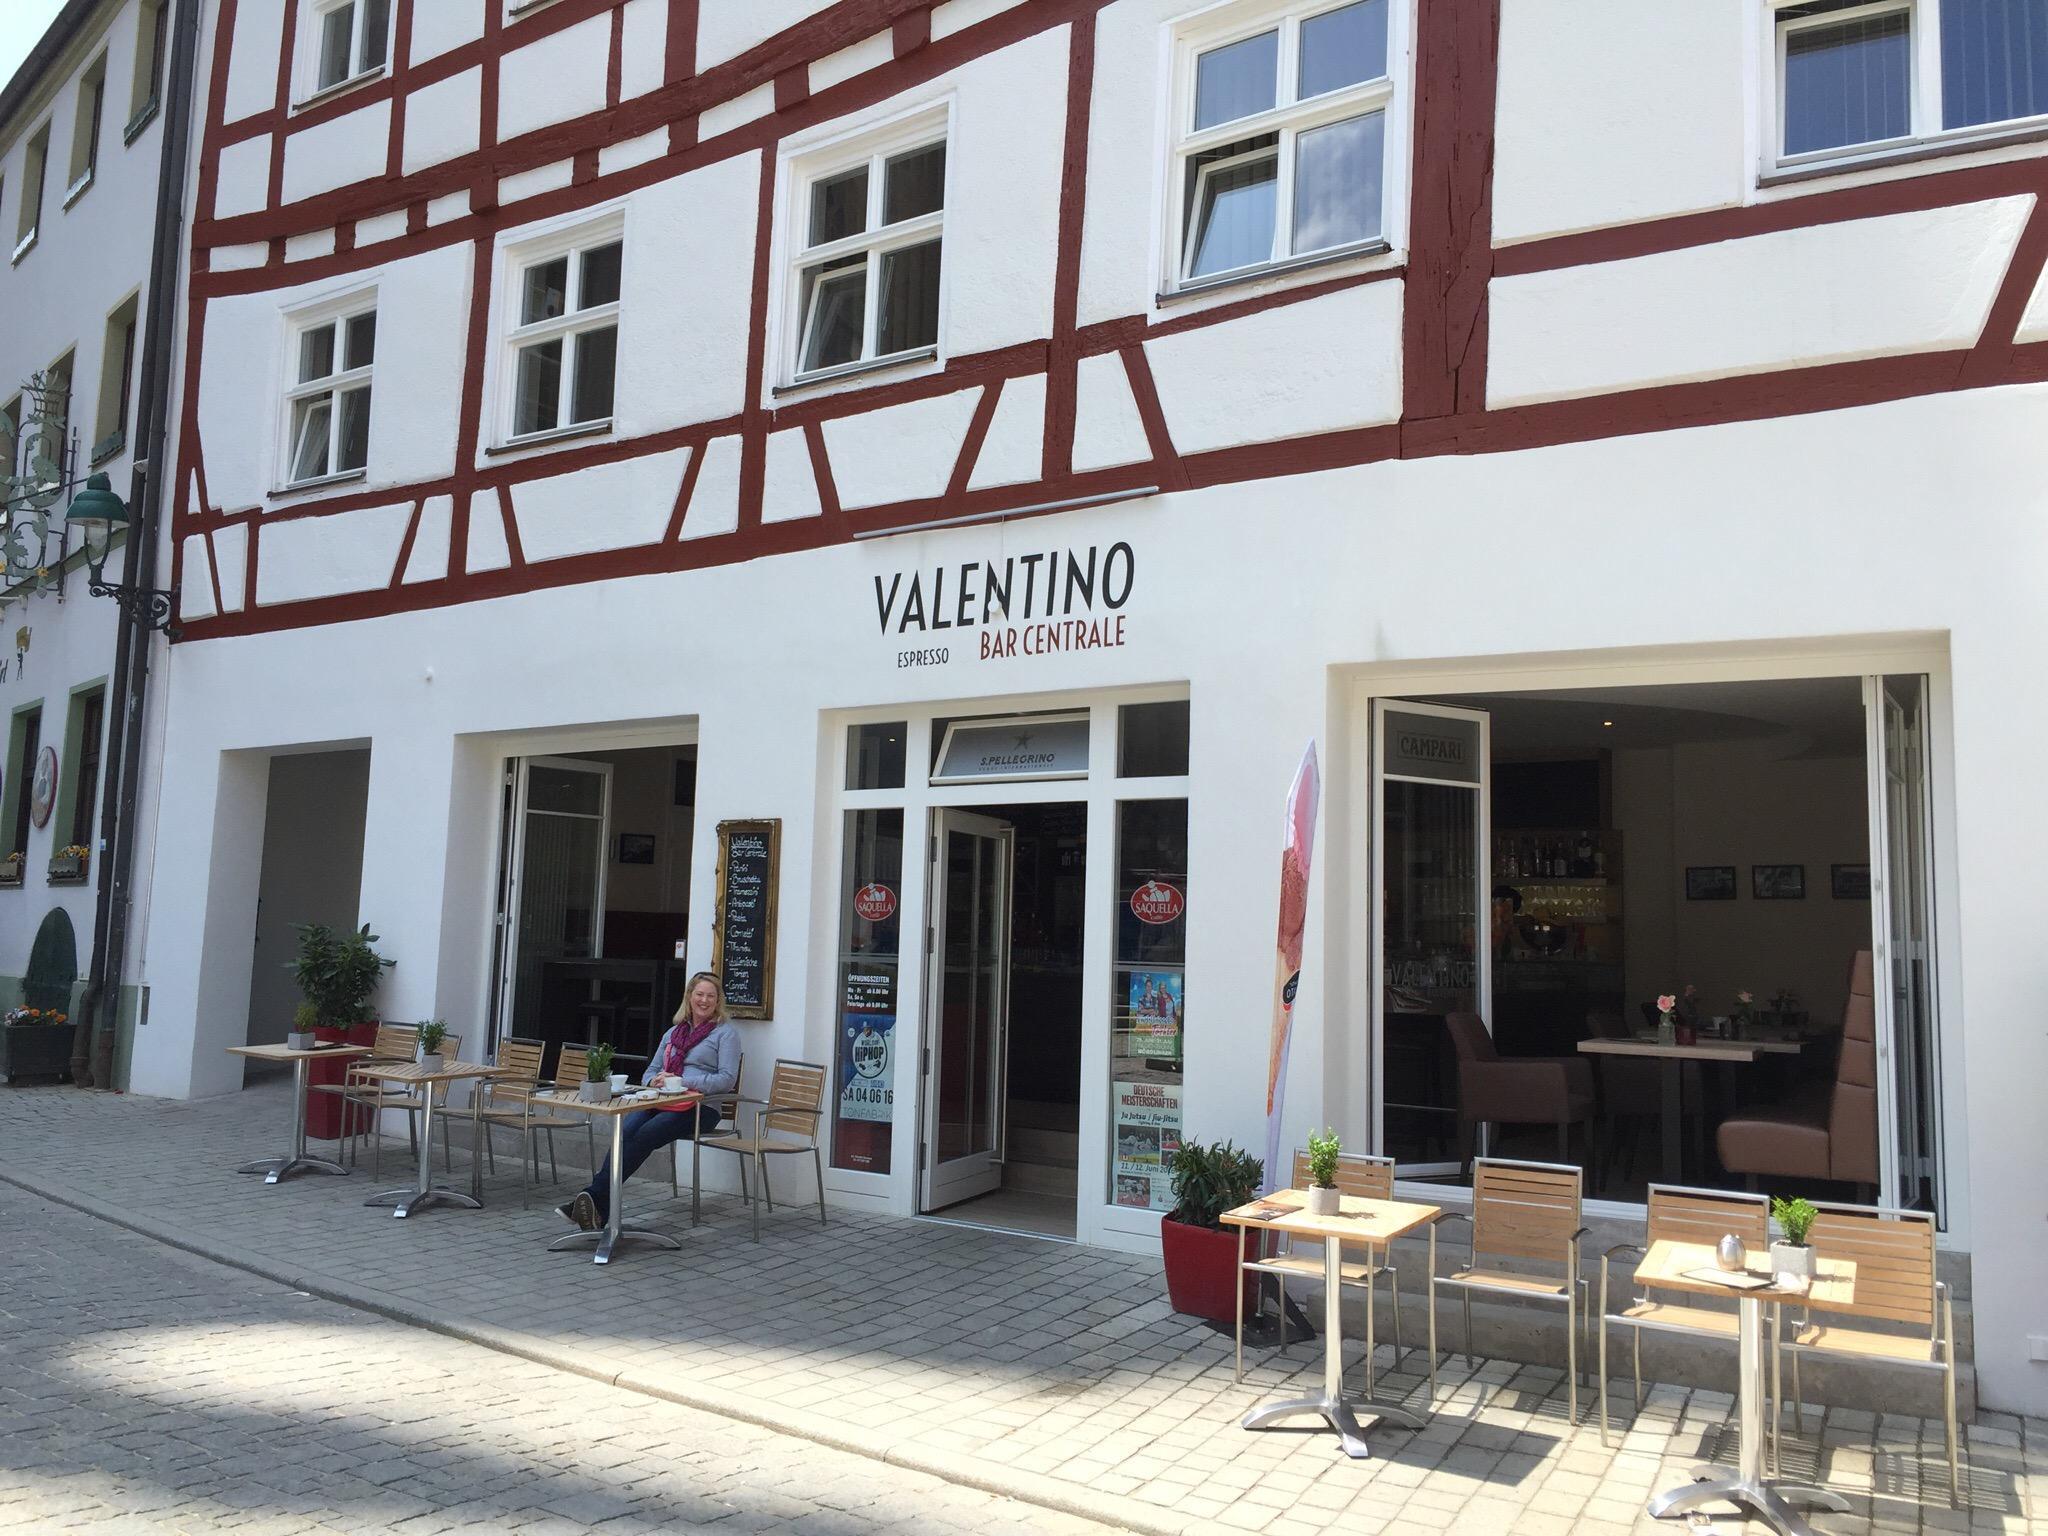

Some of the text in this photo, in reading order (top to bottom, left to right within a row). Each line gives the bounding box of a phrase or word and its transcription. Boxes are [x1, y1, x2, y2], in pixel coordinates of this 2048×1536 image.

[874, 541, 1135, 636] VALENTINO
[980, 615, 1126, 660] BAR CENTRALE
[897, 648, 949, 668] ESPRESSO
[1400, 736, 1461, 760] CAMPARI
[980, 753, 1055, 766] S.PELLEGRINO
[858, 902, 892, 914] SAQUELLA
[1135, 902, 1179, 916] SAQUELLA
[843, 1087, 893, 1105] SA 04 06 16
[1133, 1085, 1165, 1096] DEUTSCHE
[1121, 1095, 1178, 1109] MEISTERSCHAFTEN
[841, 1106, 893, 1121] TONFABRIK
[1145, 1165, 1158, 1173] Juni
